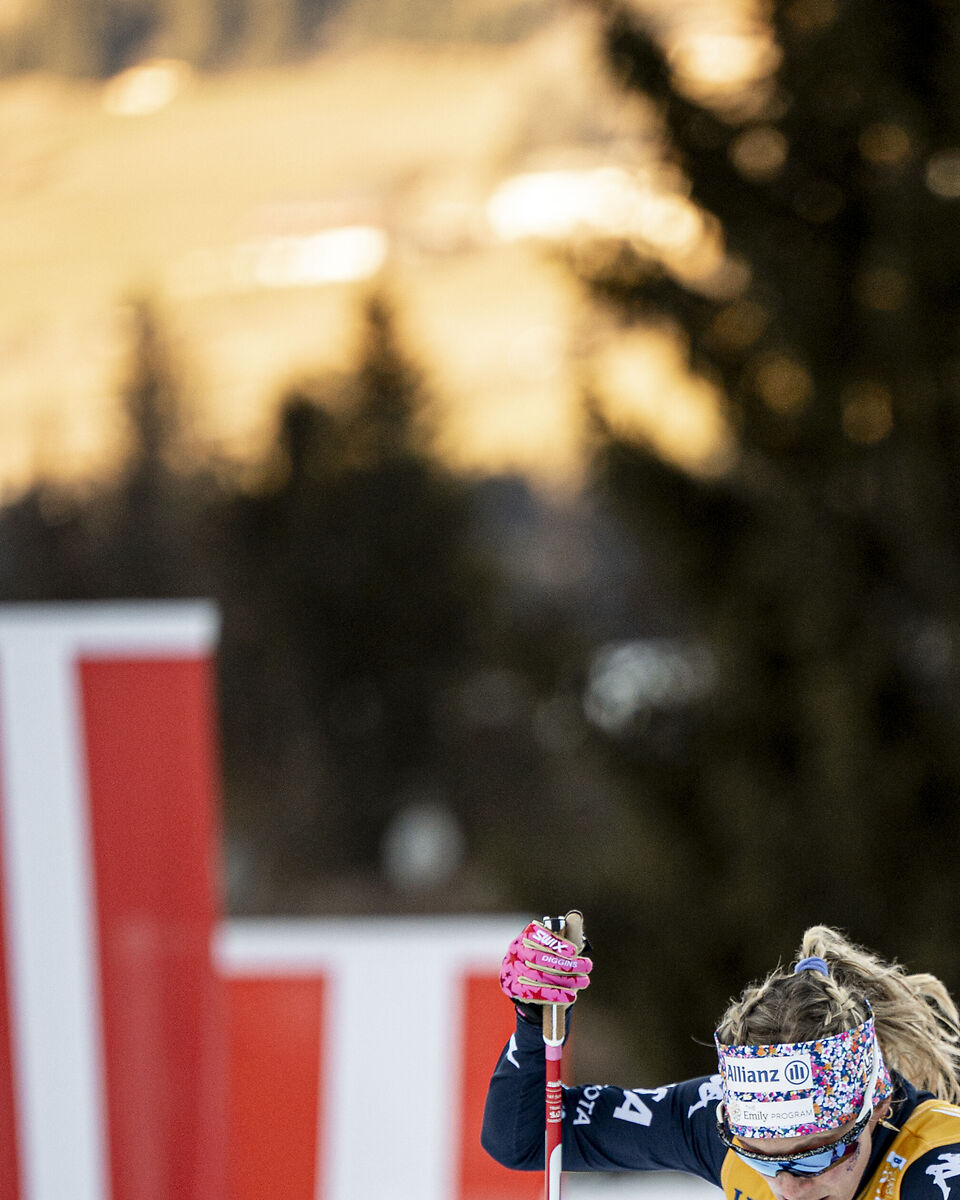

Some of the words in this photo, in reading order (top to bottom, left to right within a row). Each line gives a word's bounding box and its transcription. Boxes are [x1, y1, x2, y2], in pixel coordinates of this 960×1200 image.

[532, 929, 568, 953] SWIX
[541, 955, 578, 968] DIGGINS
[727, 1064, 780, 1084] Allianz
[743, 1110, 769, 1122] Emily
[771, 1110, 813, 1120] PROGRAM
